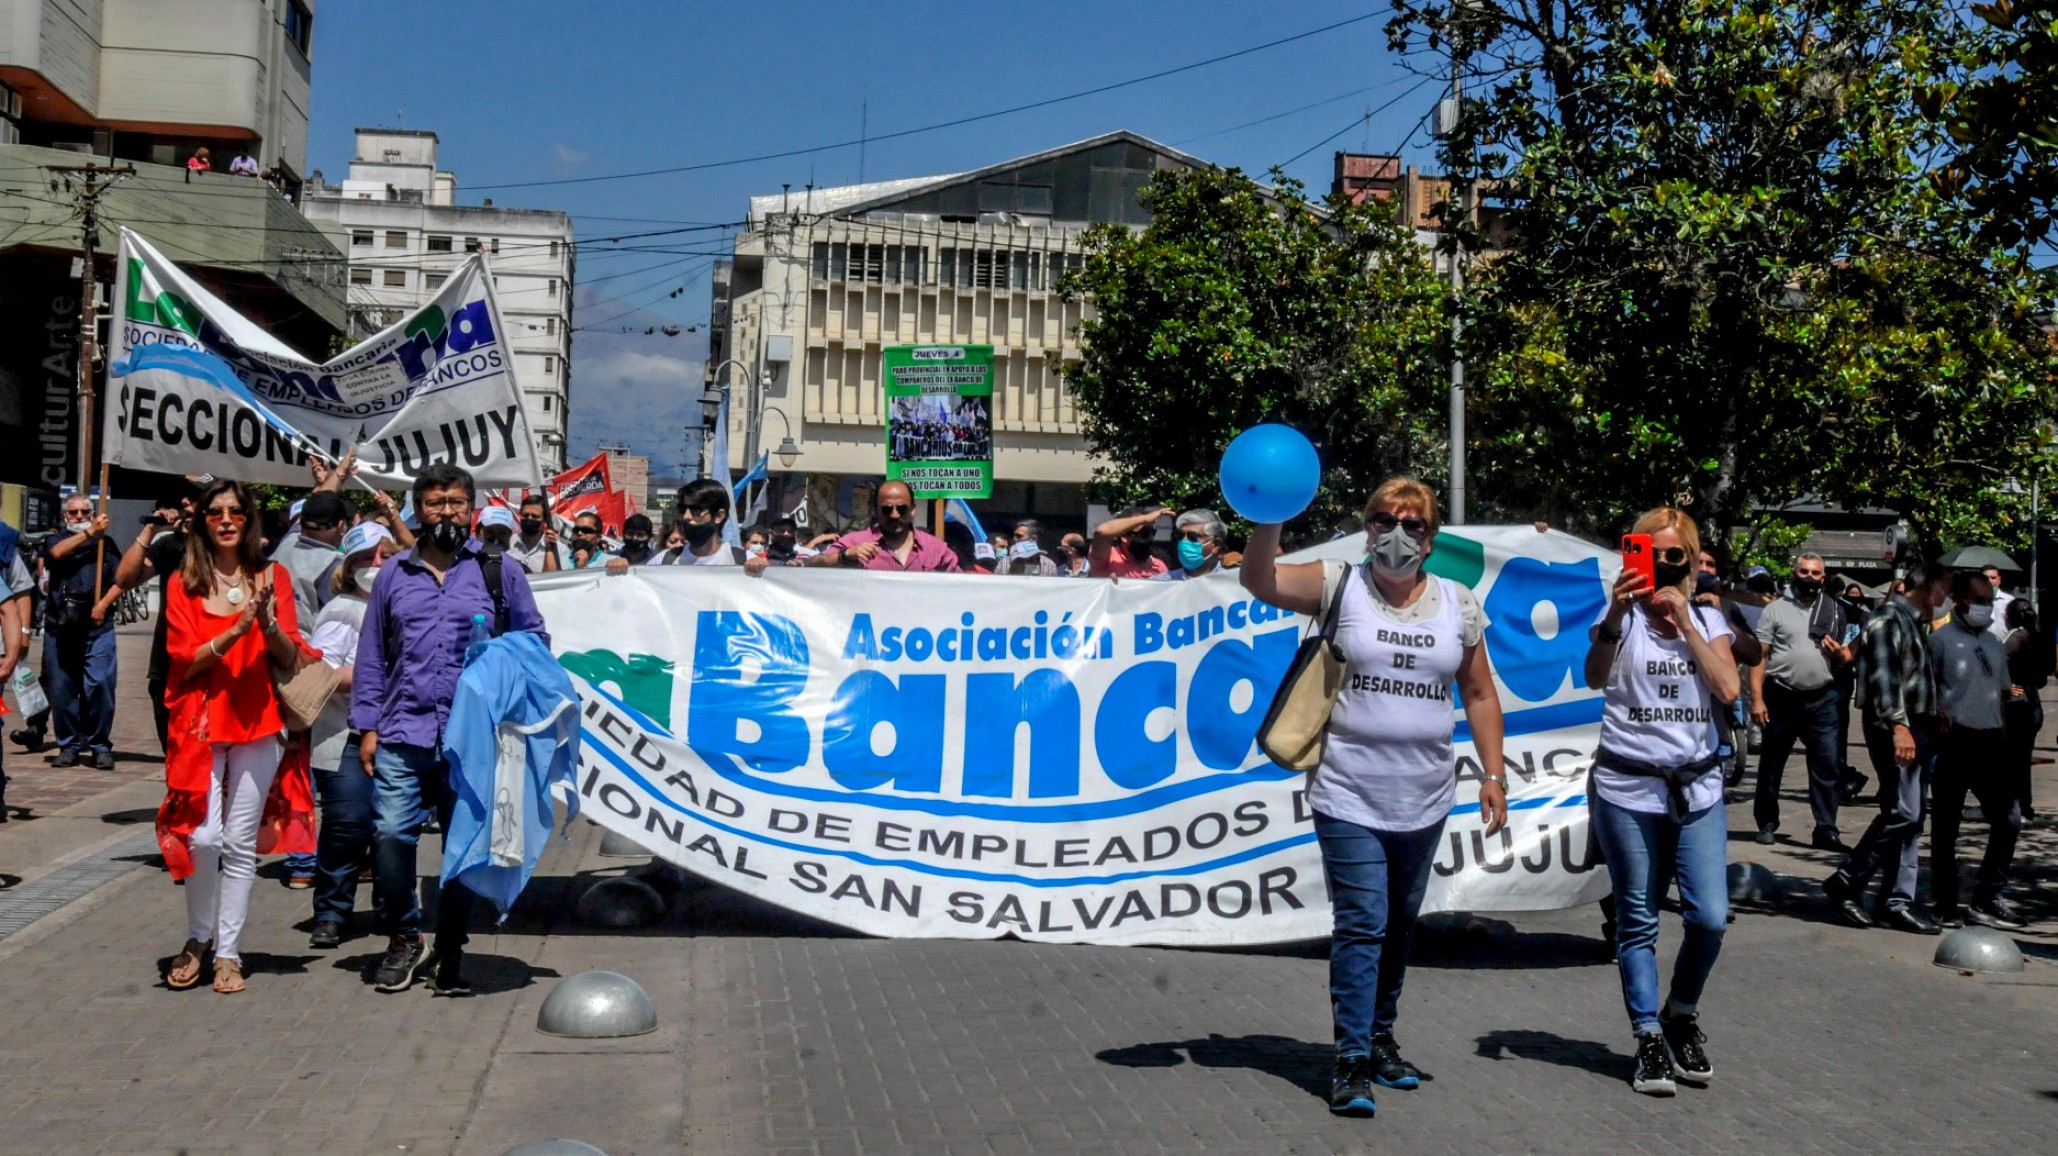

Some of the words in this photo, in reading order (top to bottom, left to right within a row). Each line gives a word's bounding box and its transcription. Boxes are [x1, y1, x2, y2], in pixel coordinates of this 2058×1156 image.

[914, 350, 949, 358] JUEVES
[908, 365, 941, 374] PROVINCIAL
[921, 386, 957, 394] DESARROLLO
[371, 404, 517, 480] JUJUY
[902, 468, 910, 478] SI
[911, 468, 926, 478] NOS
[929, 468, 954, 477] TOCAN
[956, 468, 962, 477] A
[919, 481, 945, 490] TOCAN
[947, 480, 953, 490] A
[954, 480, 982, 490] TODOS
[841, 610, 1112, 662] Asociación
[1134, 598, 1296, 656] Banca
[1376, 629, 1436, 648] BANCO
[1393, 652, 1416, 670] DE
[1646, 660, 1697, 676] BANCO
[1352, 673, 1446, 701] DESARROLLO
[1659, 684, 1679, 699] DE
[768, 808, 852, 843] DE
[875, 800, 1269, 868] EMPLEADOS
[789, 861, 922, 918] SAN
[945, 866, 1305, 934] SALVADOR
